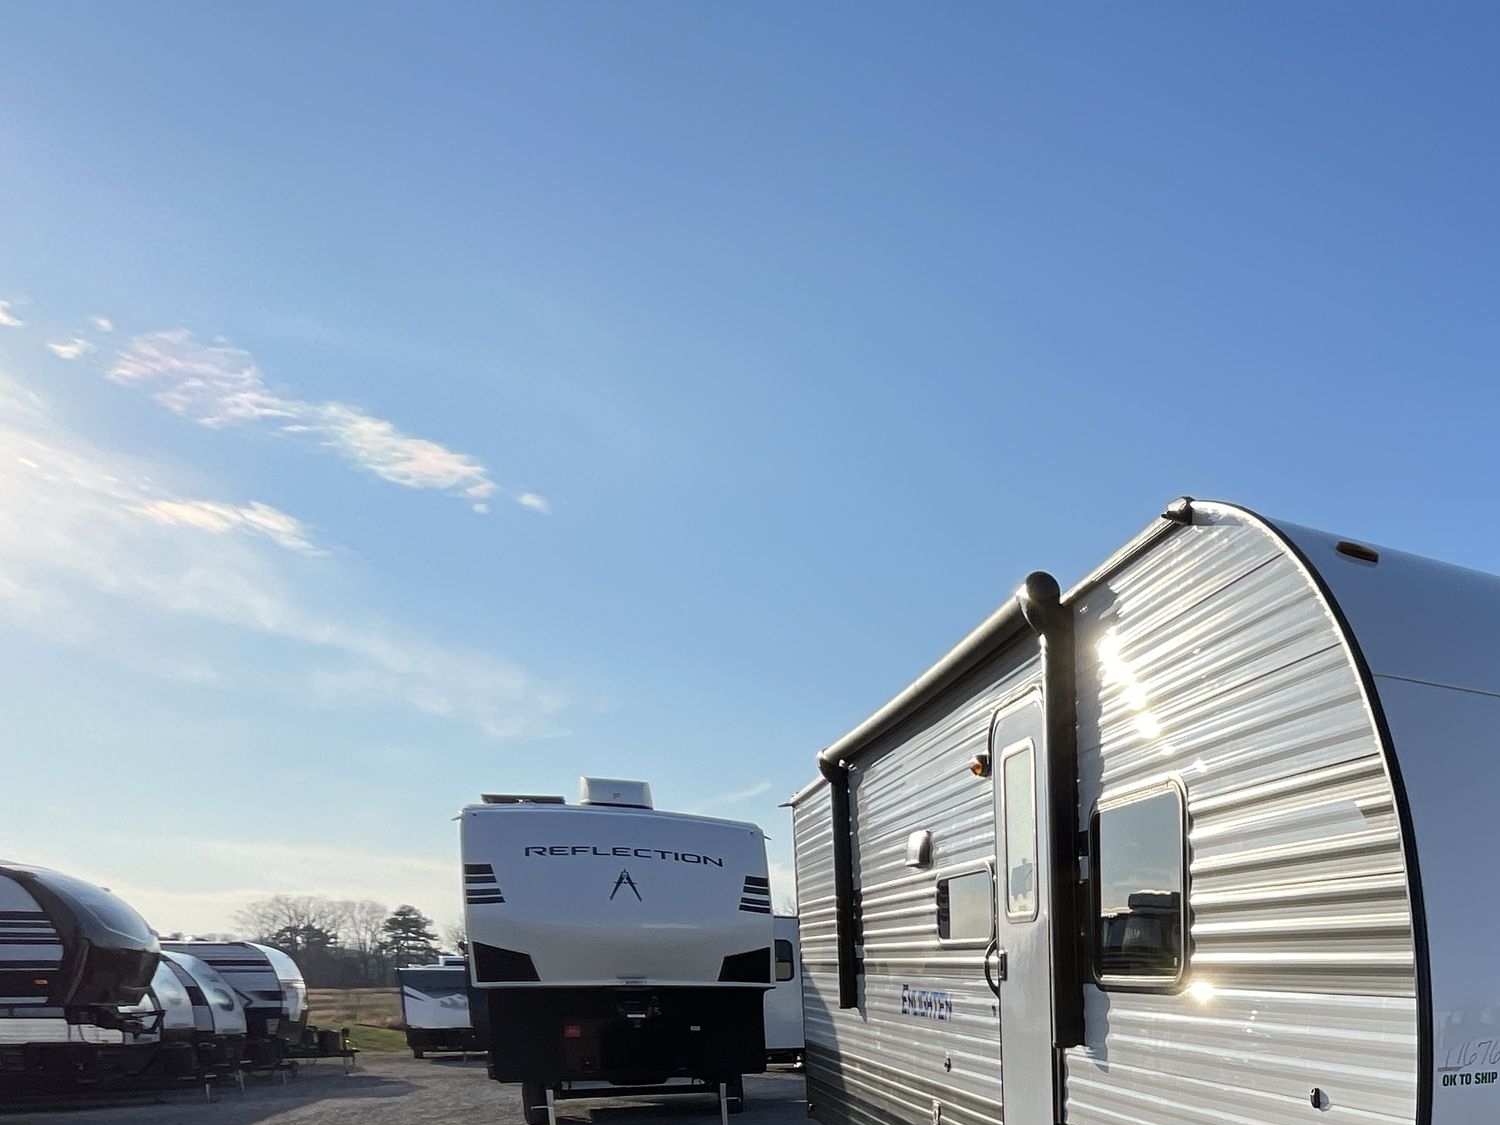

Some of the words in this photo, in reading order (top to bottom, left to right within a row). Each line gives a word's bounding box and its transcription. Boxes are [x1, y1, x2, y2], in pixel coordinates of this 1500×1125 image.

[524, 845, 725, 868] REFLECTION
[1442, 1074, 1457, 1087] OK
[1459, 1073, 1472, 1085] TO
[1474, 1071, 1498, 1085] SHIP
